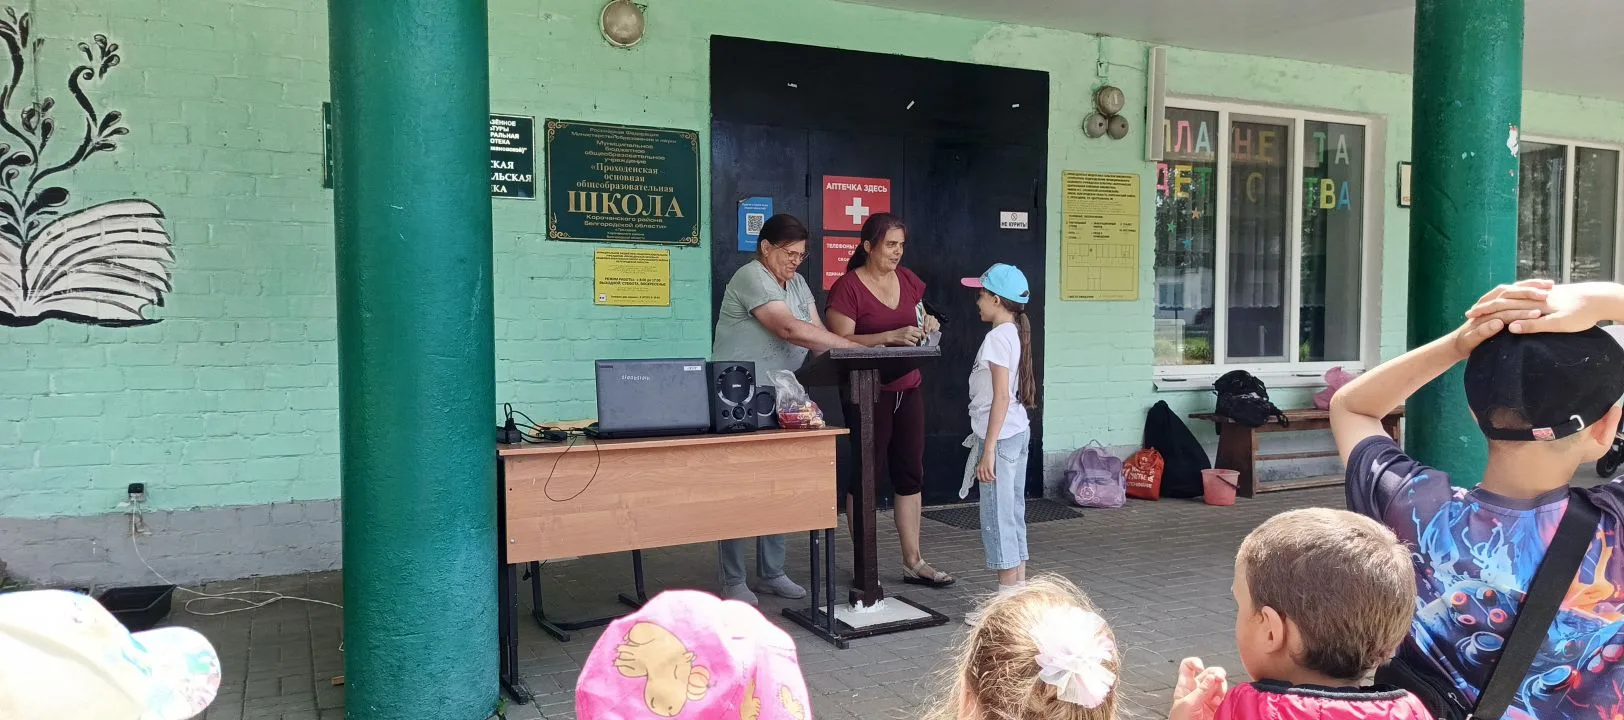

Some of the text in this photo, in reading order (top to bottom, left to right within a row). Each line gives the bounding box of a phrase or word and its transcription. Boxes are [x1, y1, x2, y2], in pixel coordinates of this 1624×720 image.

[491, 160, 515, 169] КАЯ
[491, 172, 532, 182] ЛЬСКАЯ
[603, 174, 645, 183] основная
[576, 180, 674, 193] общеобразовательная
[826, 182, 888, 193] АПТЕЧКА ЗДЕСЬ
[567, 190, 685, 218] ШКОЛА
